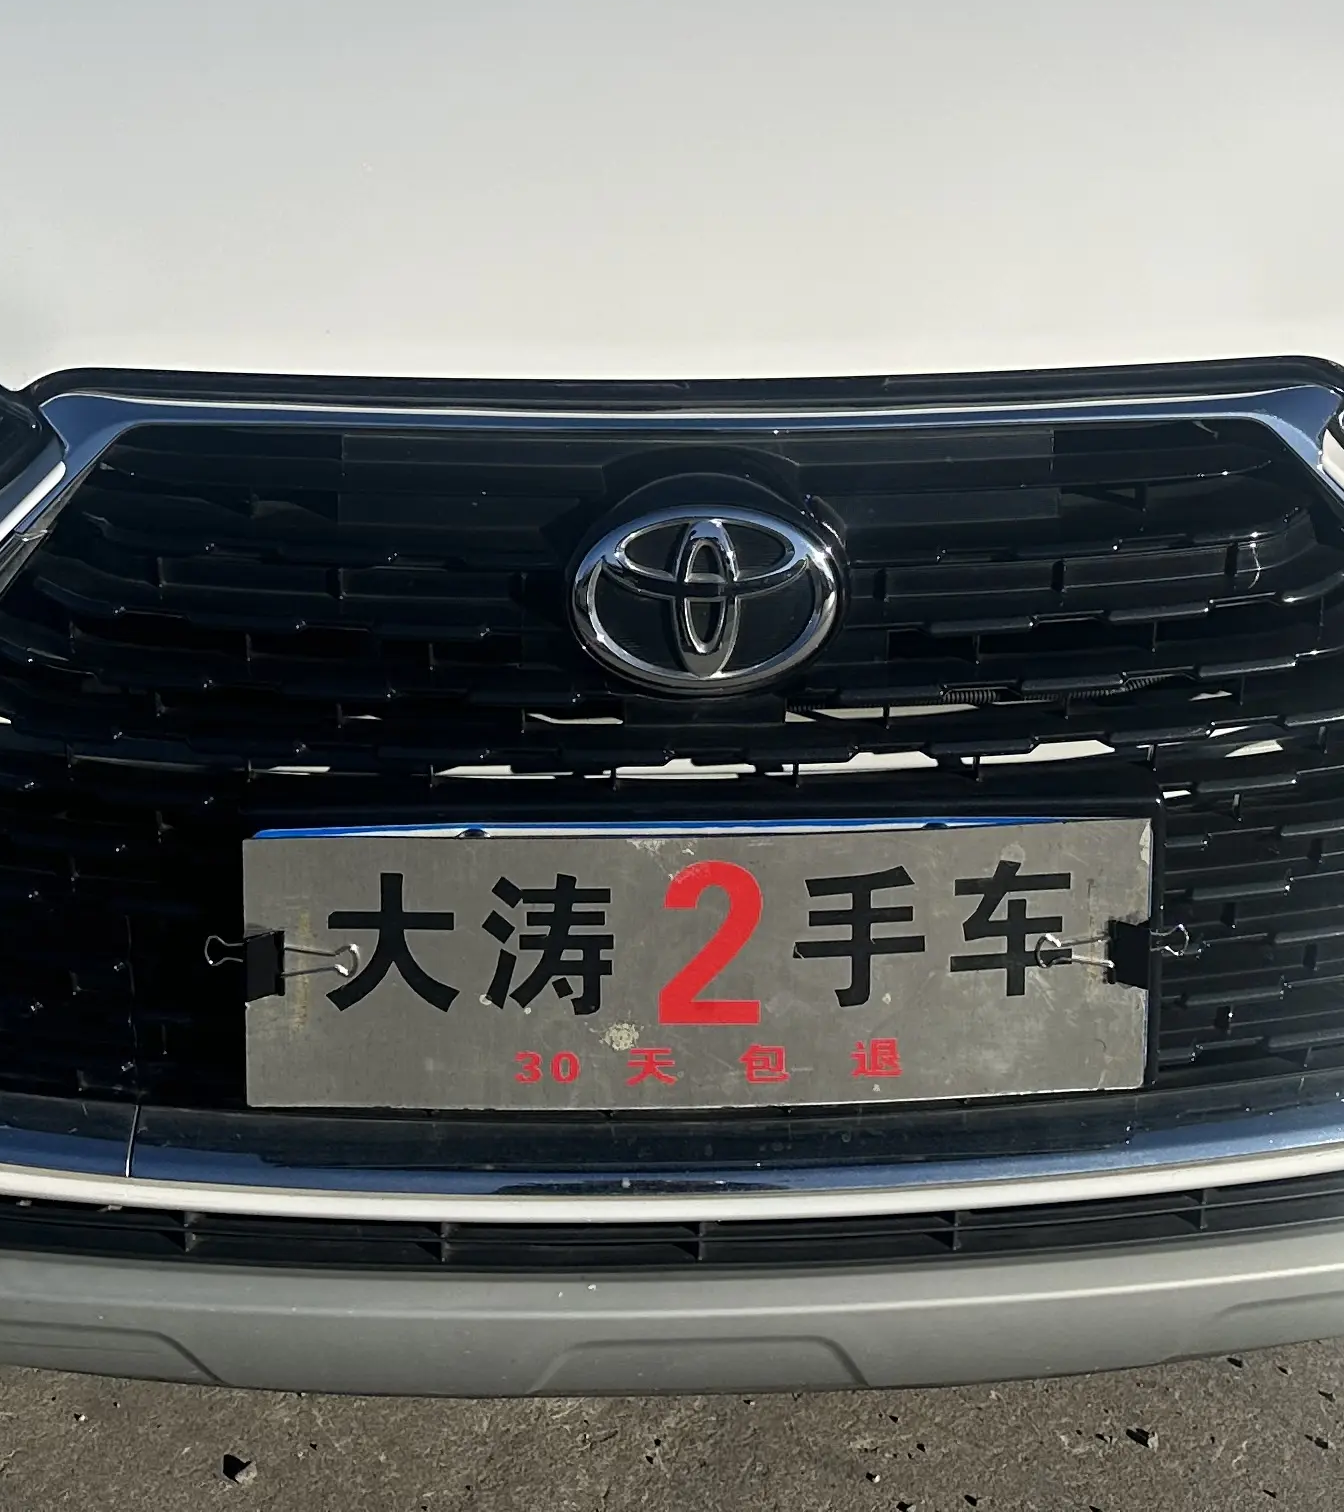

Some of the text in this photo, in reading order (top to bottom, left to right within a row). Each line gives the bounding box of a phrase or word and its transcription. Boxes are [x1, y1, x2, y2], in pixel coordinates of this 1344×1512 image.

[326, 860, 1074, 1027] 大涛2手车
[514, 1038, 903, 1087] 30天包退
